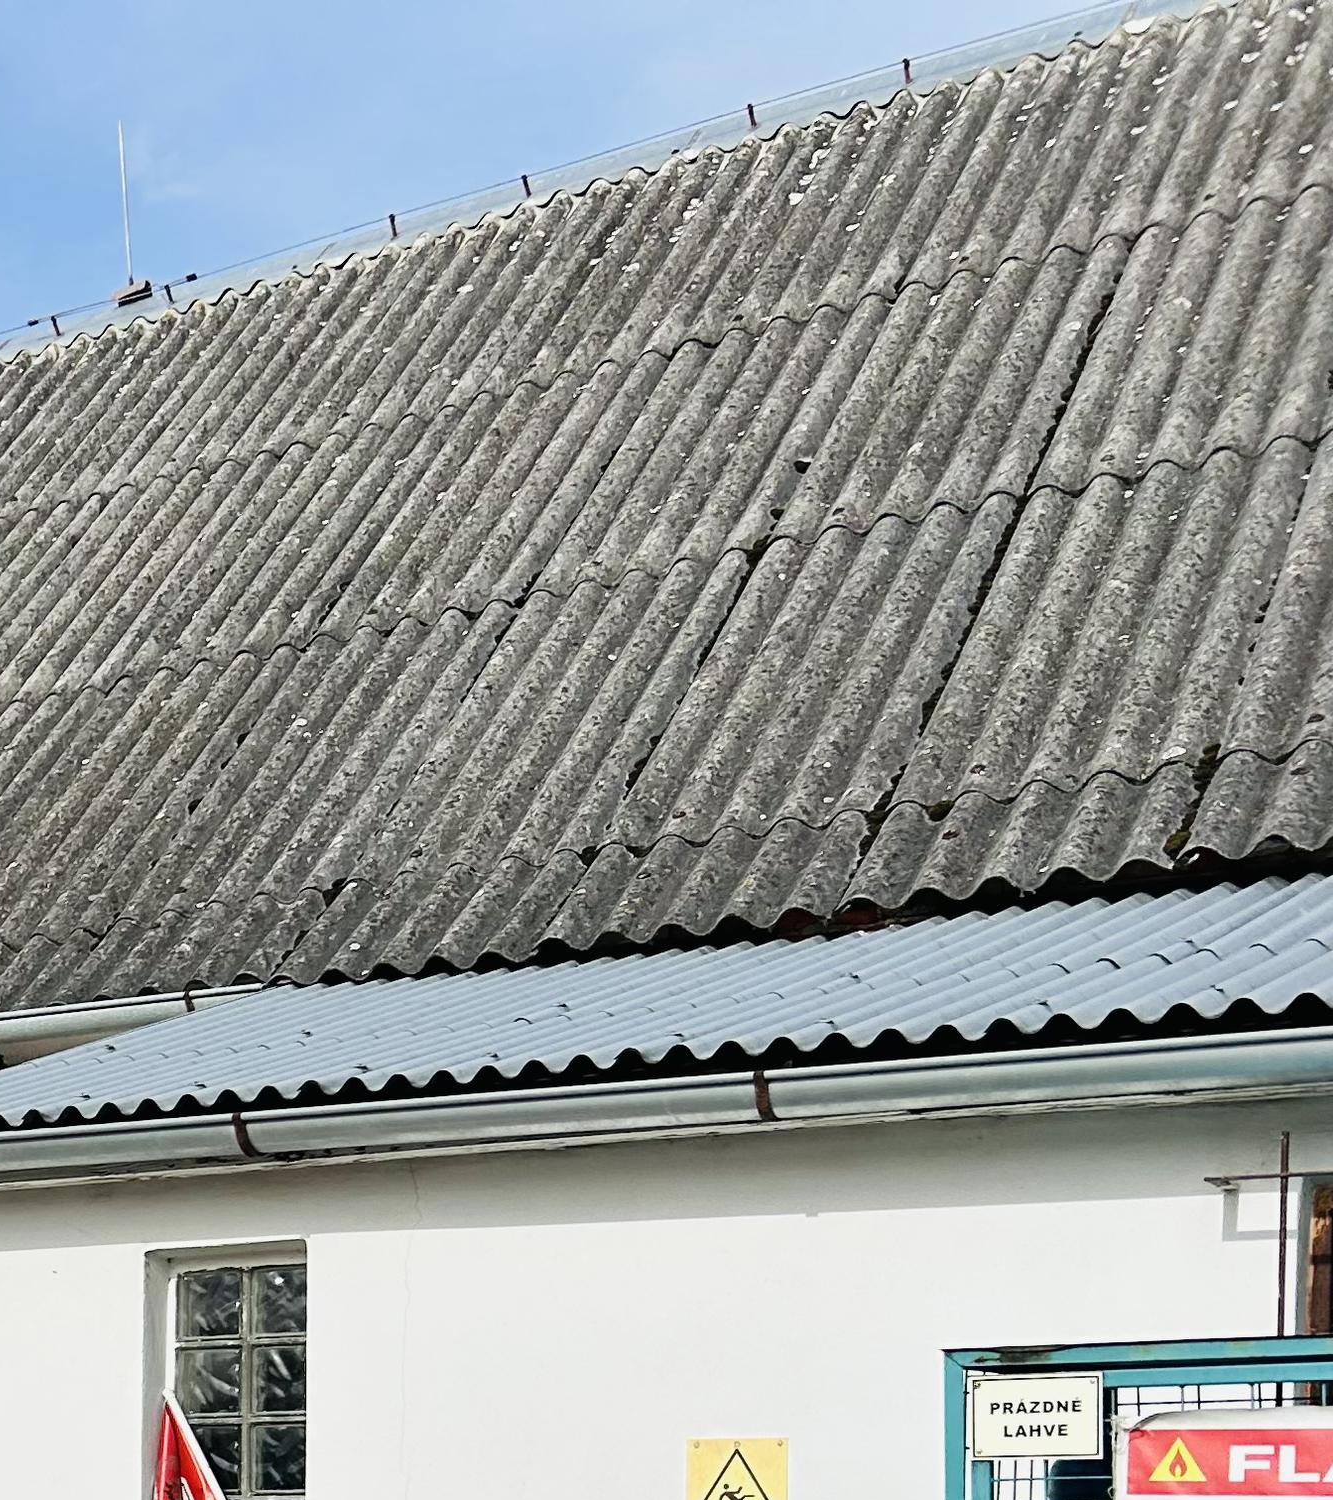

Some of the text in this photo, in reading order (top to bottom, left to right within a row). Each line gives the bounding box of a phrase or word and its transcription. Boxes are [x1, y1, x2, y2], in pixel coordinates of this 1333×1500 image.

[990, 1398, 1082, 1414] PRÁZDNÉ
[1004, 1424, 1068, 1437] LAHVE
[1228, 1444, 1333, 1483] FL
